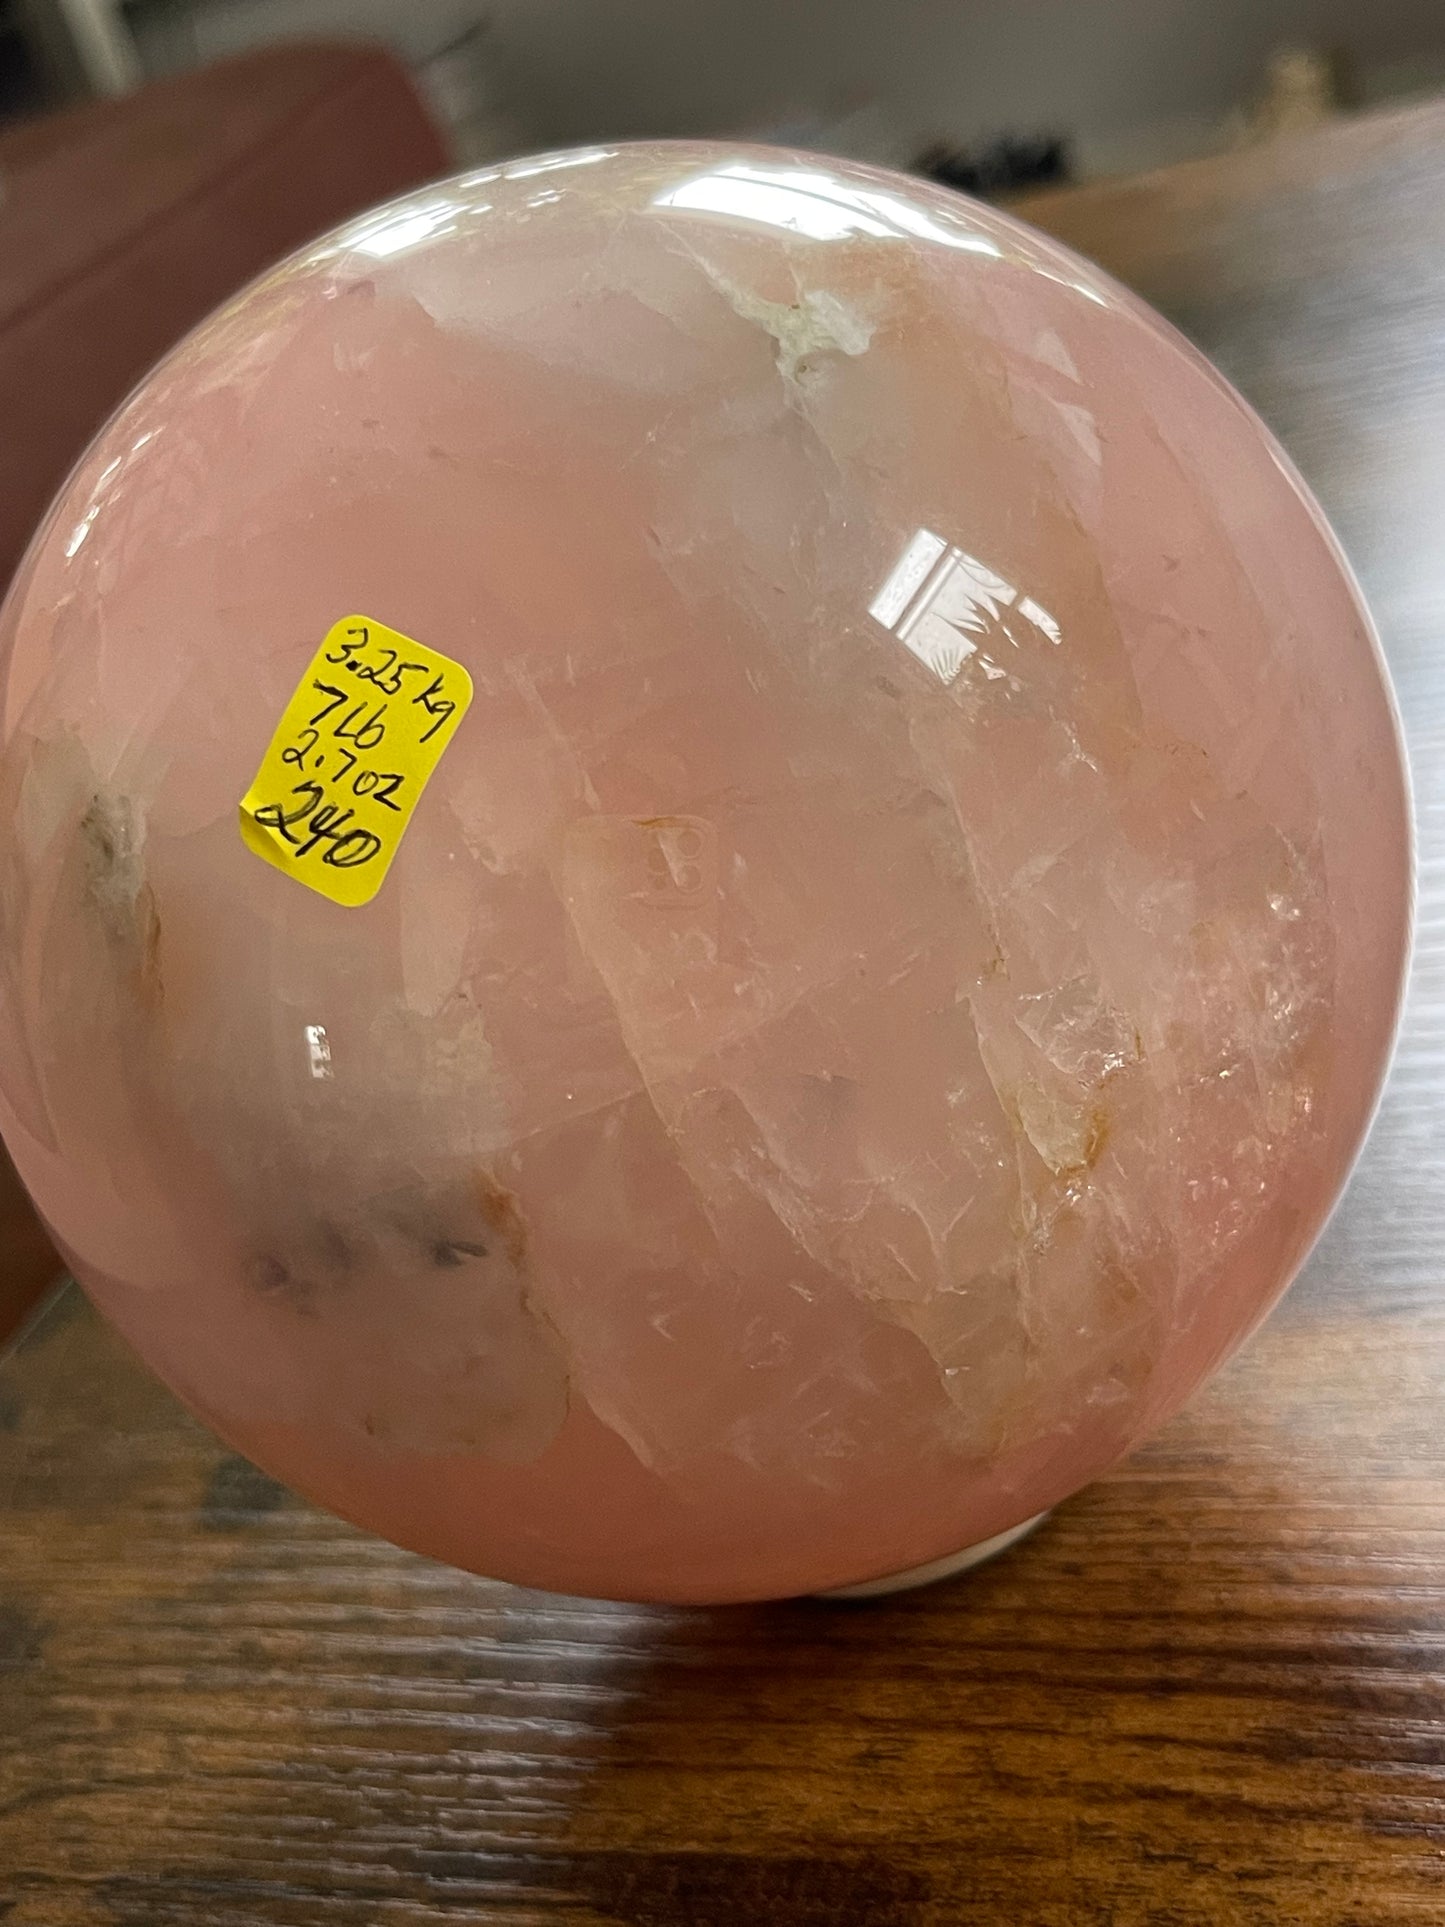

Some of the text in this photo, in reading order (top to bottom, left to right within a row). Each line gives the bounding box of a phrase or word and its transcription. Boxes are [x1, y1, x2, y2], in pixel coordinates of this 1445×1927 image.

[326, 628, 429, 695] 3.25
[310, 679, 349, 726] 7
[282, 728, 357, 782] 2.7
[254, 780, 381, 868] 240
